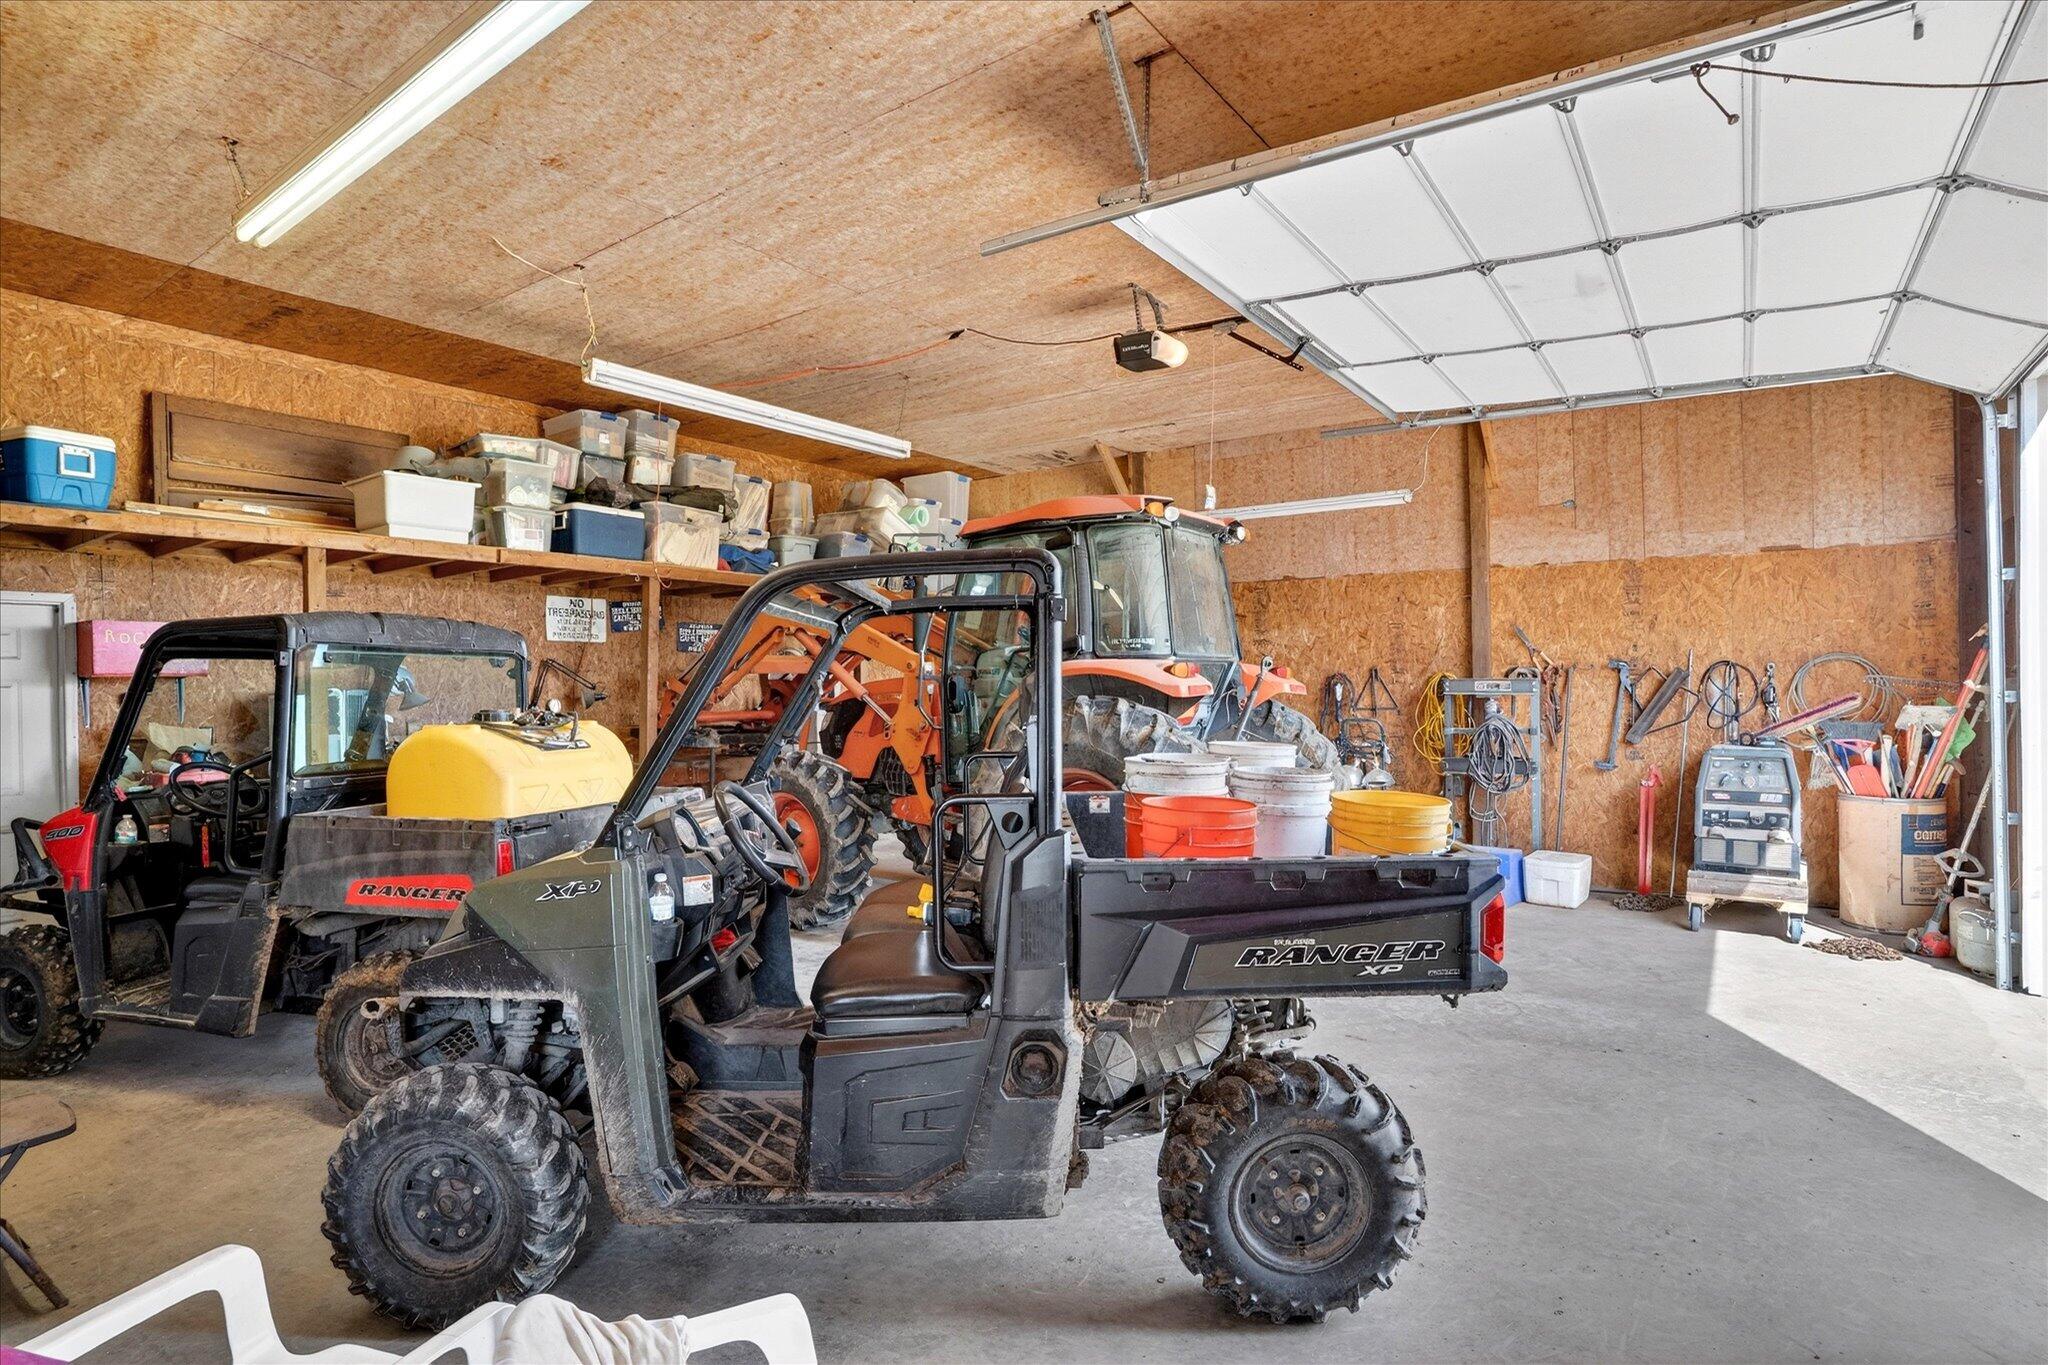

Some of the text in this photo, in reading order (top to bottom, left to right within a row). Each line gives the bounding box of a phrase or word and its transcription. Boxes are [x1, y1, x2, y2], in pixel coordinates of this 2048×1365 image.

[569, 599, 584, 608] NO
[105, 629, 149, 645] ROC
[358, 883, 467, 902] RANGER
[535, 879, 602, 901] XP
[1234, 939, 1446, 967] RANGER
[1354, 963, 1404, 978] XP
